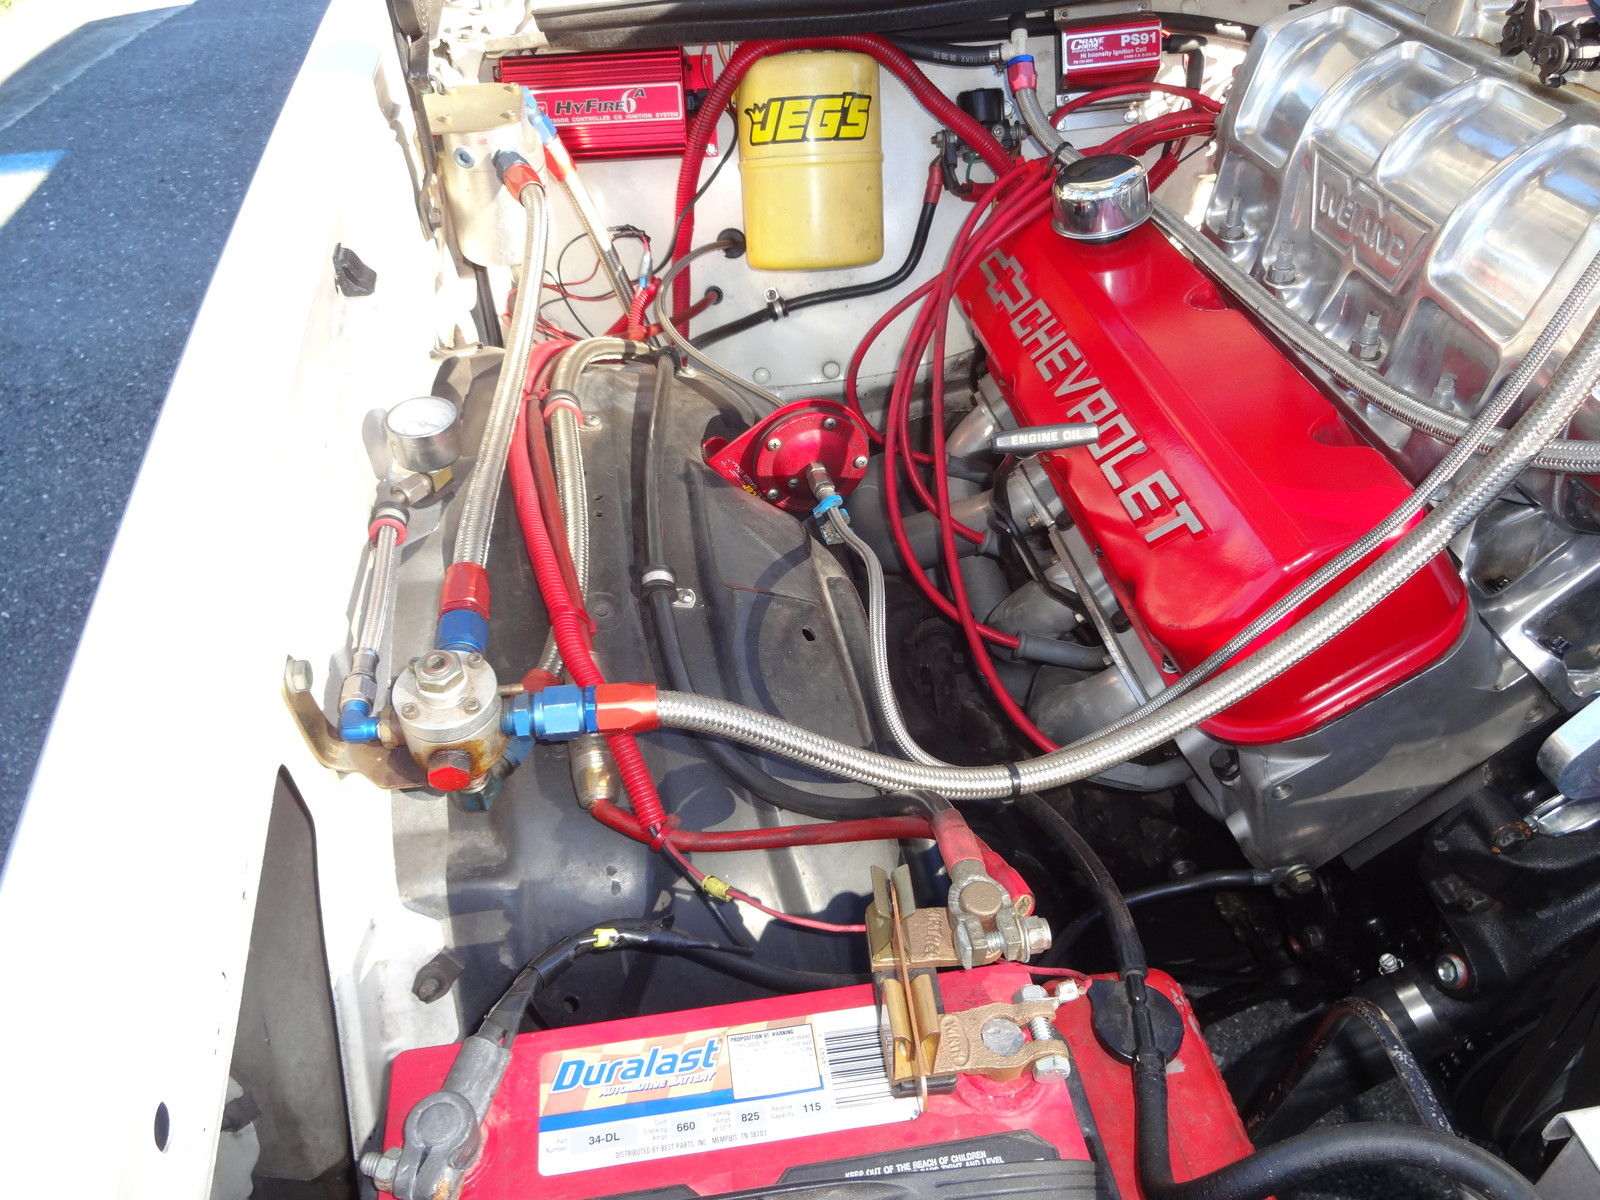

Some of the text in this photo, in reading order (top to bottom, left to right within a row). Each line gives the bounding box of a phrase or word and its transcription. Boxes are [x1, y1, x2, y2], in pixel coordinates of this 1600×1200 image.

[1121, 31, 1157, 47] PS91
[1088, 50, 1112, 58] Intensity
[1113, 48, 1135, 57] Ignition
[572, 114, 610, 122] CONTROLLED
[625, 112, 653, 120] IGNITION
[745, 92, 871, 146] JEG'S
[1010, 298, 1204, 542] CHEVROLET
[1011, 429, 1083, 446] ENGINE OIL
[730, 1033, 763, 1043] PROPOSITION
[772, 1029, 794, 1037] WARNING
[552, 1038, 721, 1092] Duralast
[599, 1071, 717, 1097] AUTOMOTIVE BATTERY
[803, 1102, 822, 1113] 115
[741, 1111, 760, 1123] 825
[676, 1121, 696, 1132] 660
[588, 1132, 620, 1145] 34-DL
[615, 1147, 651, 1159] DISTRIBUTED
[652, 1145, 659, 1153] BY
[661, 1143, 674, 1151] BEST
[676, 1140, 694, 1149] PARTS
[866, 1167, 881, 1175] OUT
[883, 1165, 894, 1174] OF
[896, 1163, 912, 1172] THE
[912, 1158, 937, 1169] REACH
[939, 1156, 949, 1166] OF
[950, 1150, 987, 1163] CHILDREN
